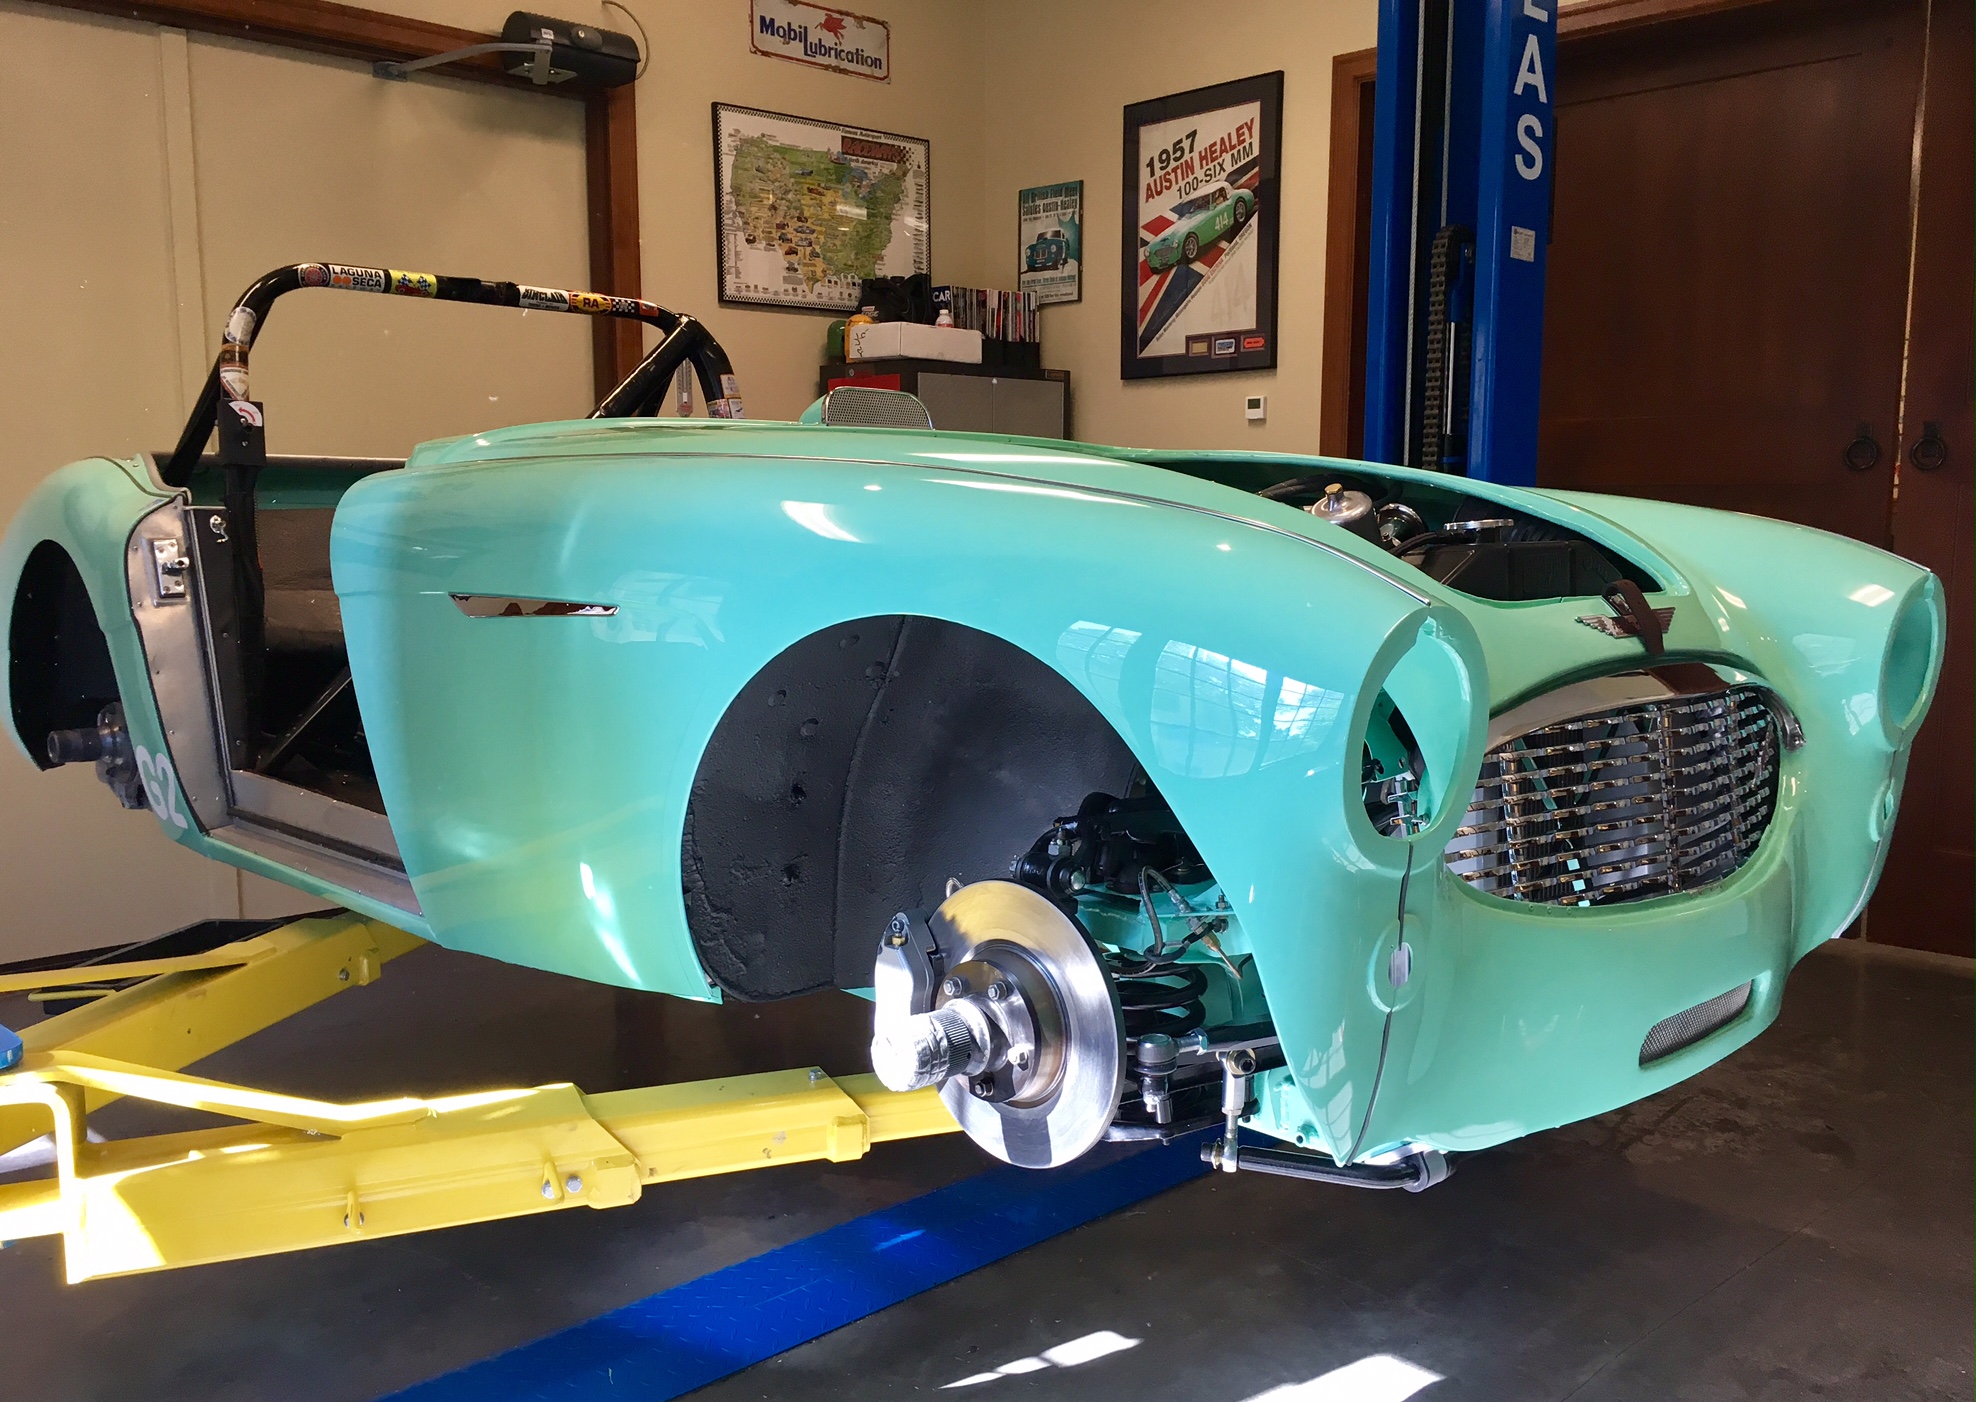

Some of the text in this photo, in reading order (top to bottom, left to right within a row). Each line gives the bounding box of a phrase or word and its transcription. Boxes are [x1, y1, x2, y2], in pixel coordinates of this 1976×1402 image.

[1144, 116, 1255, 204] AUSTIN HEALEY
[1145, 128, 1198, 179] 1957
[1176, 141, 1254, 200] 100-SIX MM
[1214, 211, 1229, 231] 414
[331, 266, 382, 279] LAGUNA
[352, 277, 382, 288] SECA
[583, 297, 600, 309] RA
[932, 289, 950, 302] CAR
[135, 745, 189, 830] 62
